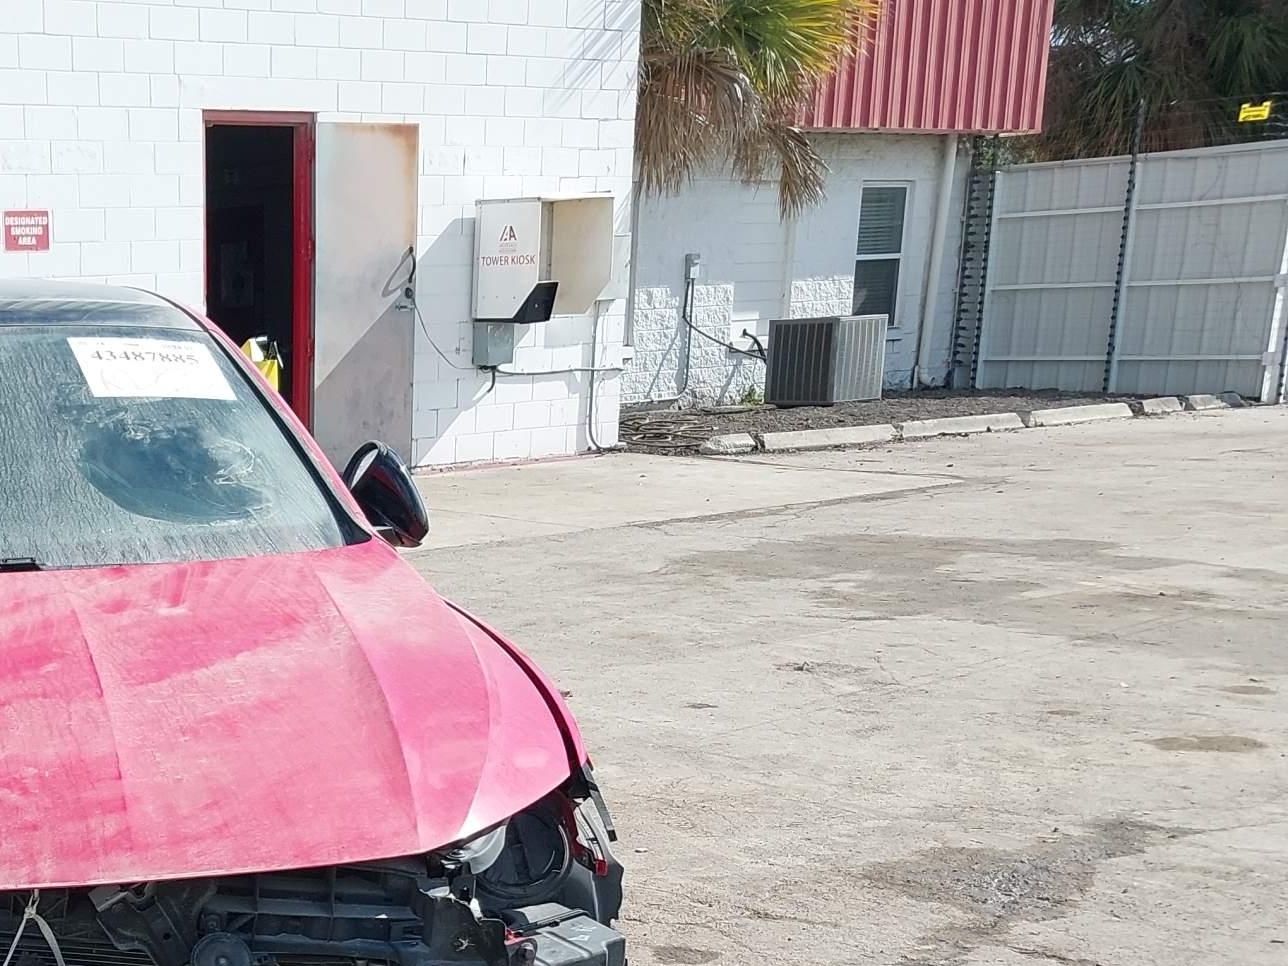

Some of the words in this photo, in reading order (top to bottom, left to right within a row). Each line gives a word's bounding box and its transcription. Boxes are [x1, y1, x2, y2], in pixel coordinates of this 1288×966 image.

[5, 216, 48, 225] DESIGNATED
[11, 226, 43, 235] SMOKING
[18, 236, 37, 245] AREA
[481, 256, 509, 266] TOWER
[510, 255, 535, 265] KIOSK
[91, 350, 199, 365] 43487885
